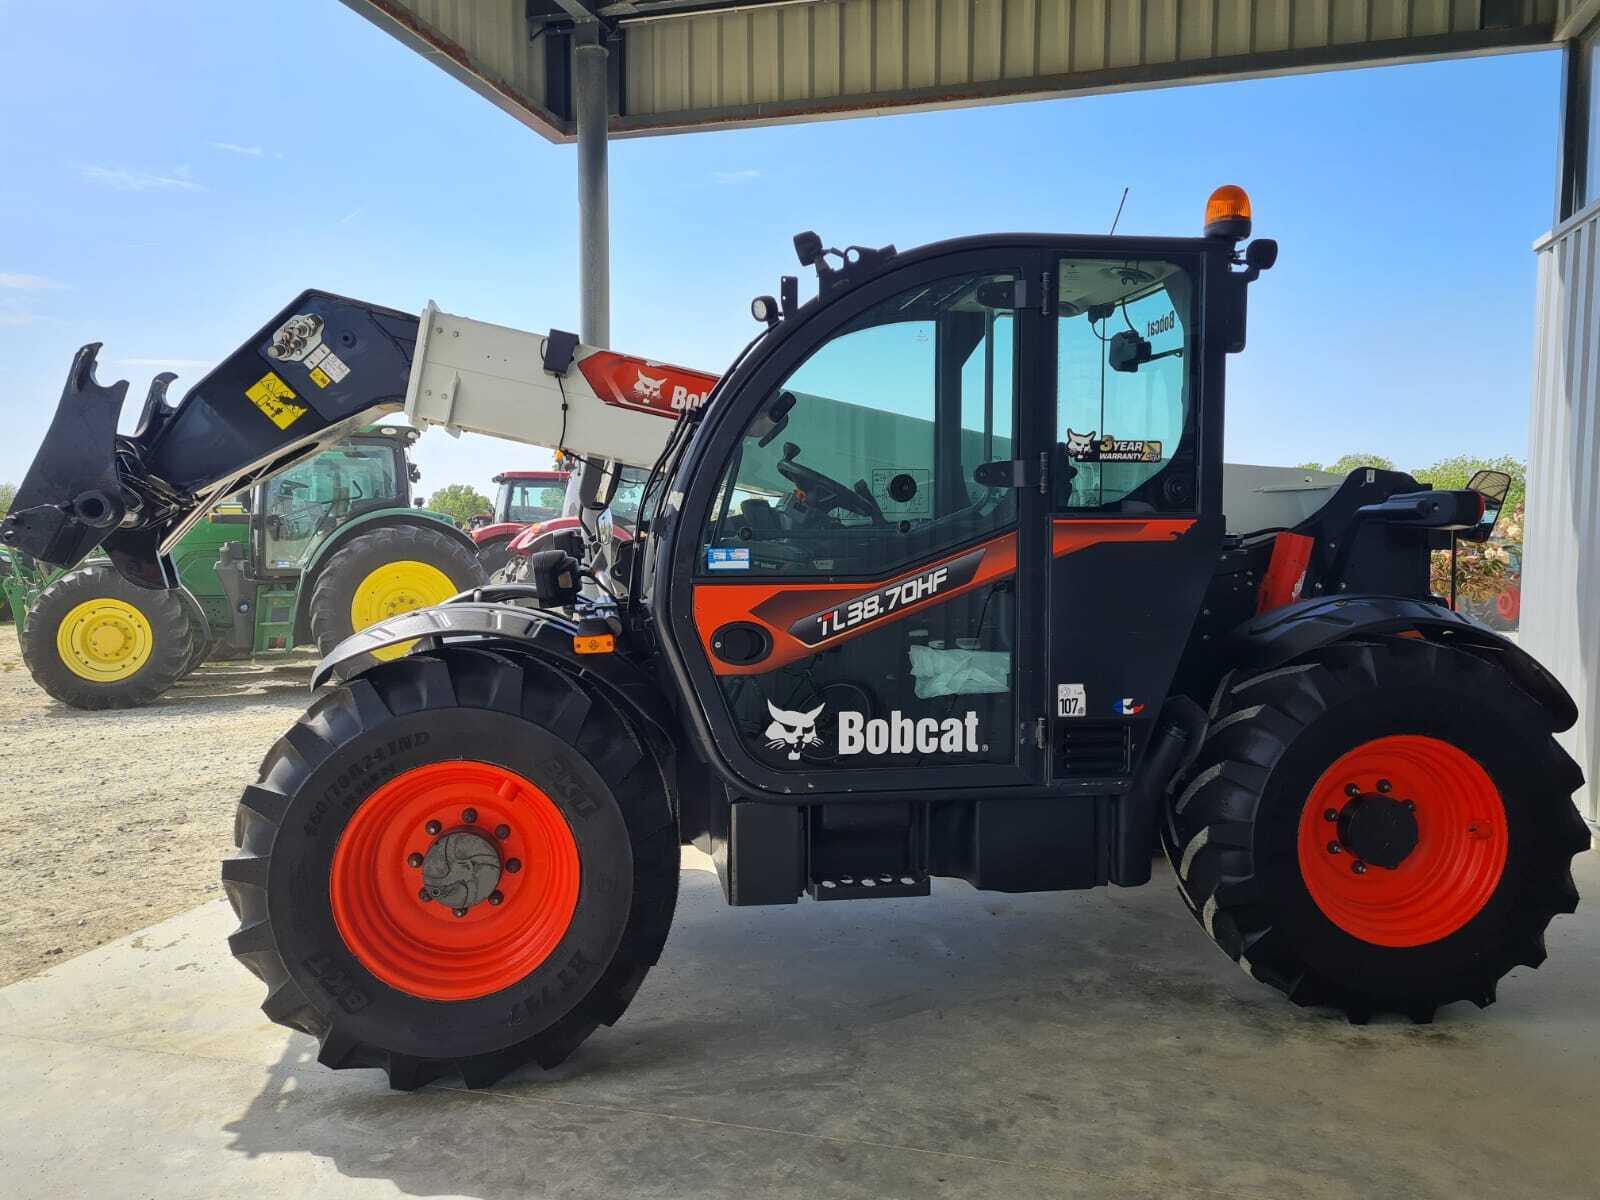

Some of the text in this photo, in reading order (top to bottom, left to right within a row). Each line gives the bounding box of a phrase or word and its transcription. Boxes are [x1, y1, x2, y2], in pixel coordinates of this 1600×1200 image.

[1113, 441, 1143, 451] YEAR
[1099, 452, 1143, 460] WARRANTY
[816, 567, 948, 637] TL38.70HF
[1059, 698, 1078, 714] 107
[838, 710, 979, 755] Bobcat
